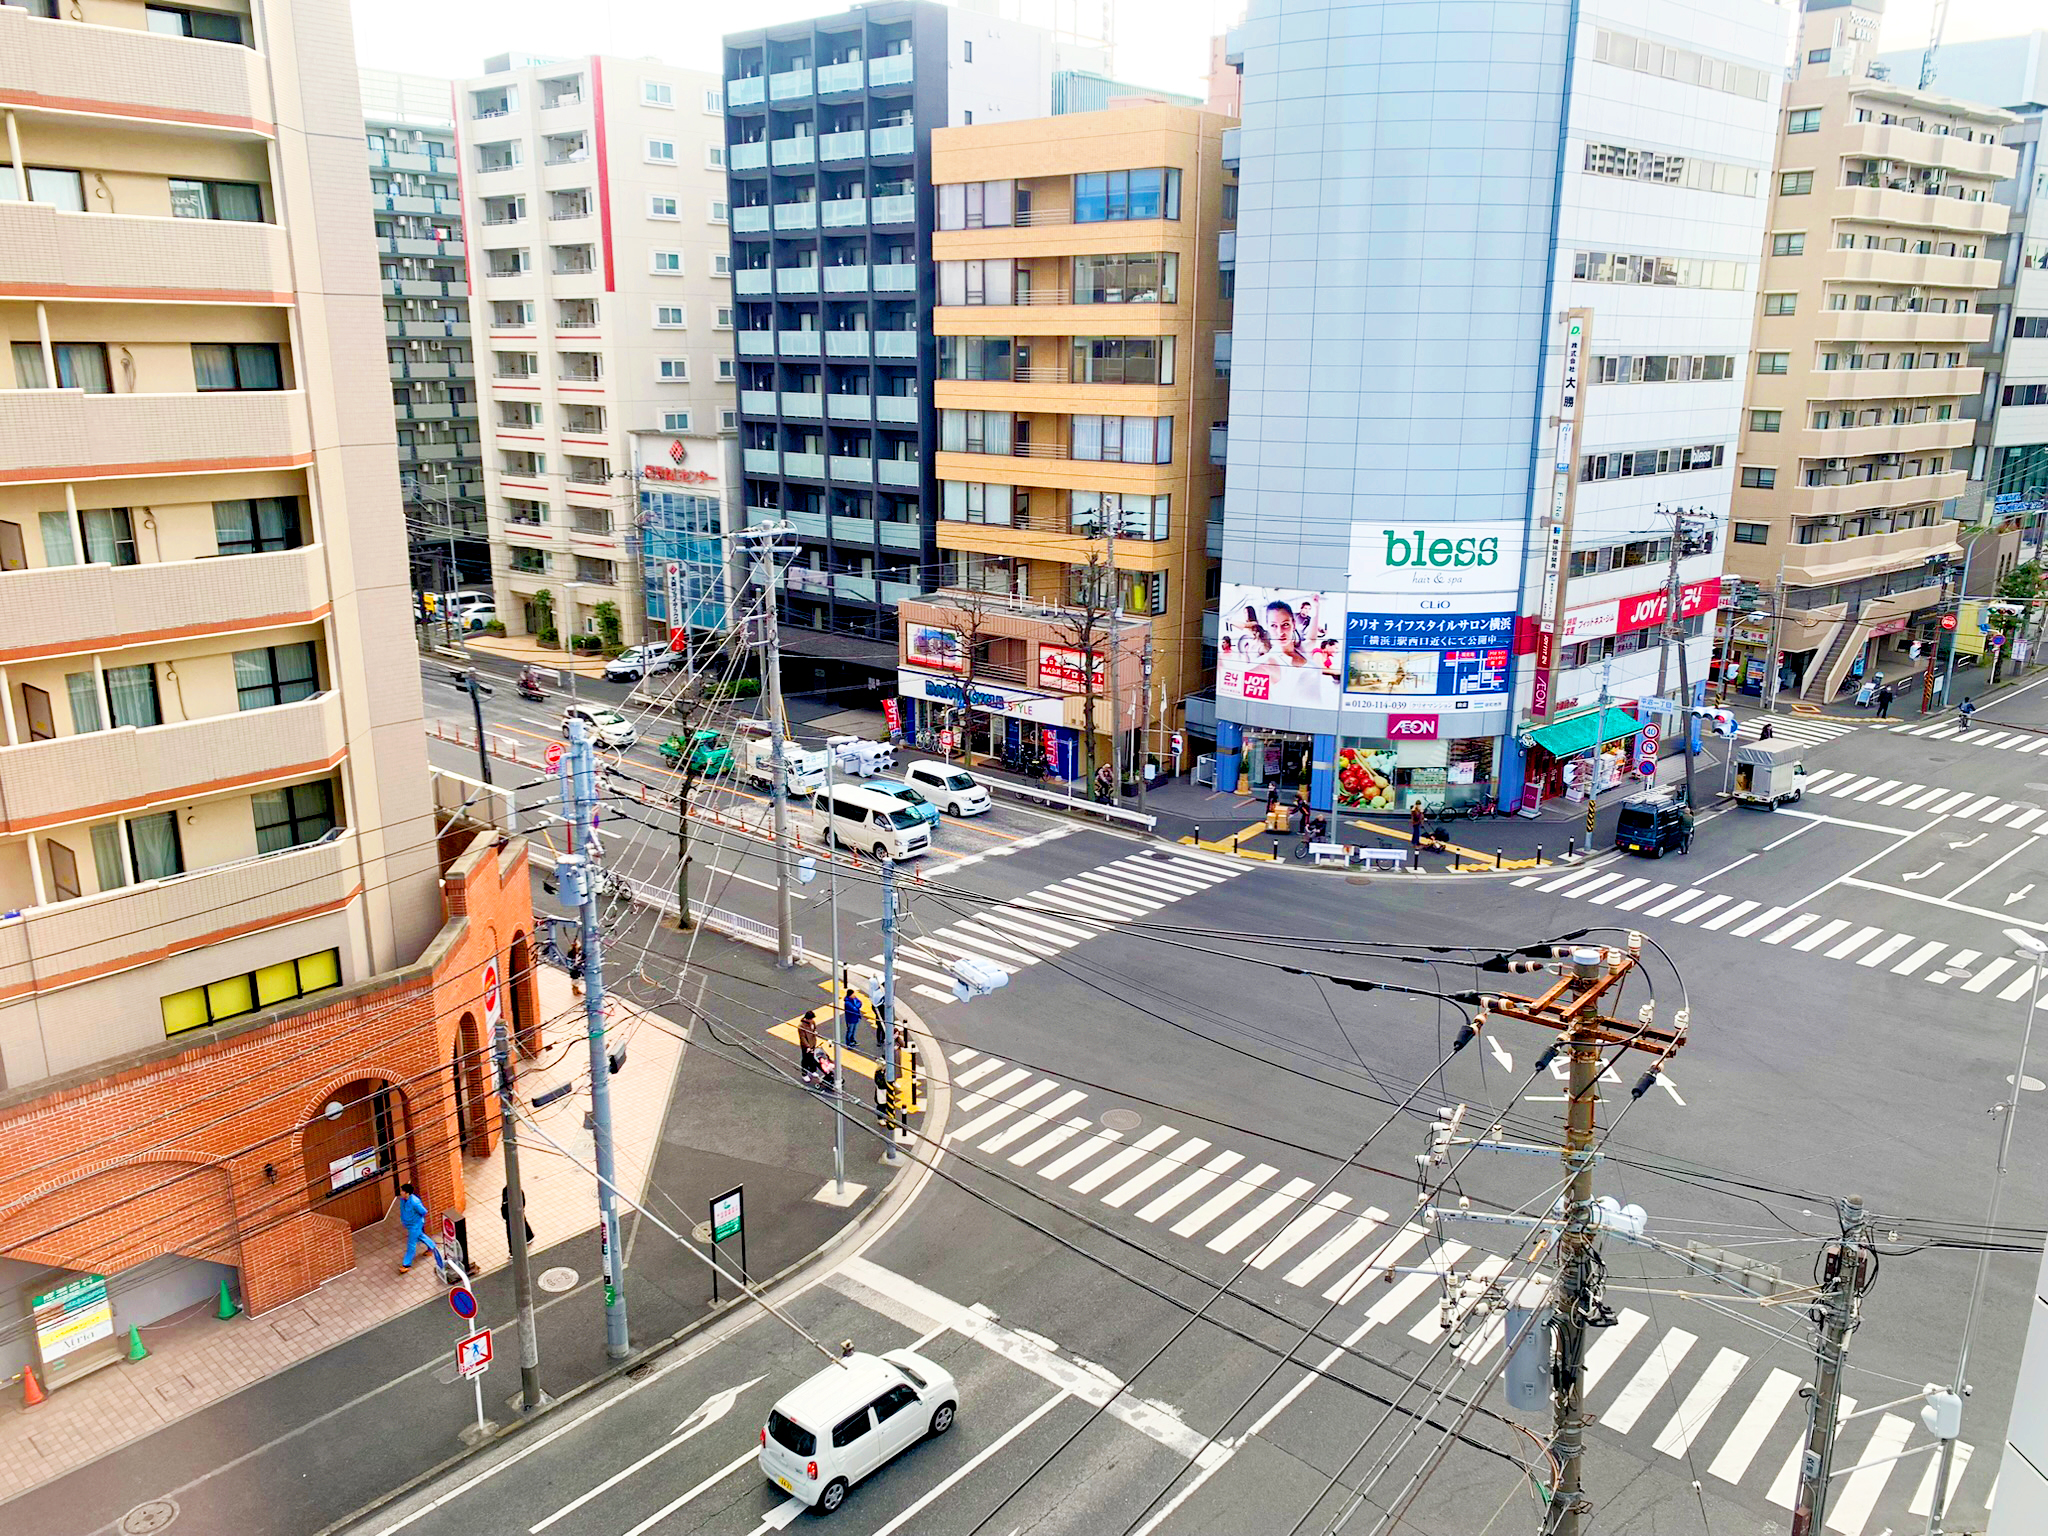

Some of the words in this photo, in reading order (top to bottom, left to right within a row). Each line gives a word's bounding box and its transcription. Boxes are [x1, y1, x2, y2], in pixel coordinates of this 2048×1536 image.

[1383, 530, 1499, 567] bless
[1412, 571, 1430, 584] hair
[1433, 573, 1445, 584] &
[1447, 575, 1462, 586] spa
[1348, 618, 1379, 631] クリオ
[1384, 617, 1511, 631] ライフスタイルサロン横浜
[1362, 635, 1497, 646] 「横浜」駅西口近くにて公開中
[1224, 671, 1238, 682] 24
[1244, 675, 1268, 687] JOY
[1245, 684, 1266, 697] FIT
[1008, 702, 1032, 716] STYLE
[1352, 700, 1406, 709] 0120-114-039
[1646, 728, 1656, 736] 40
